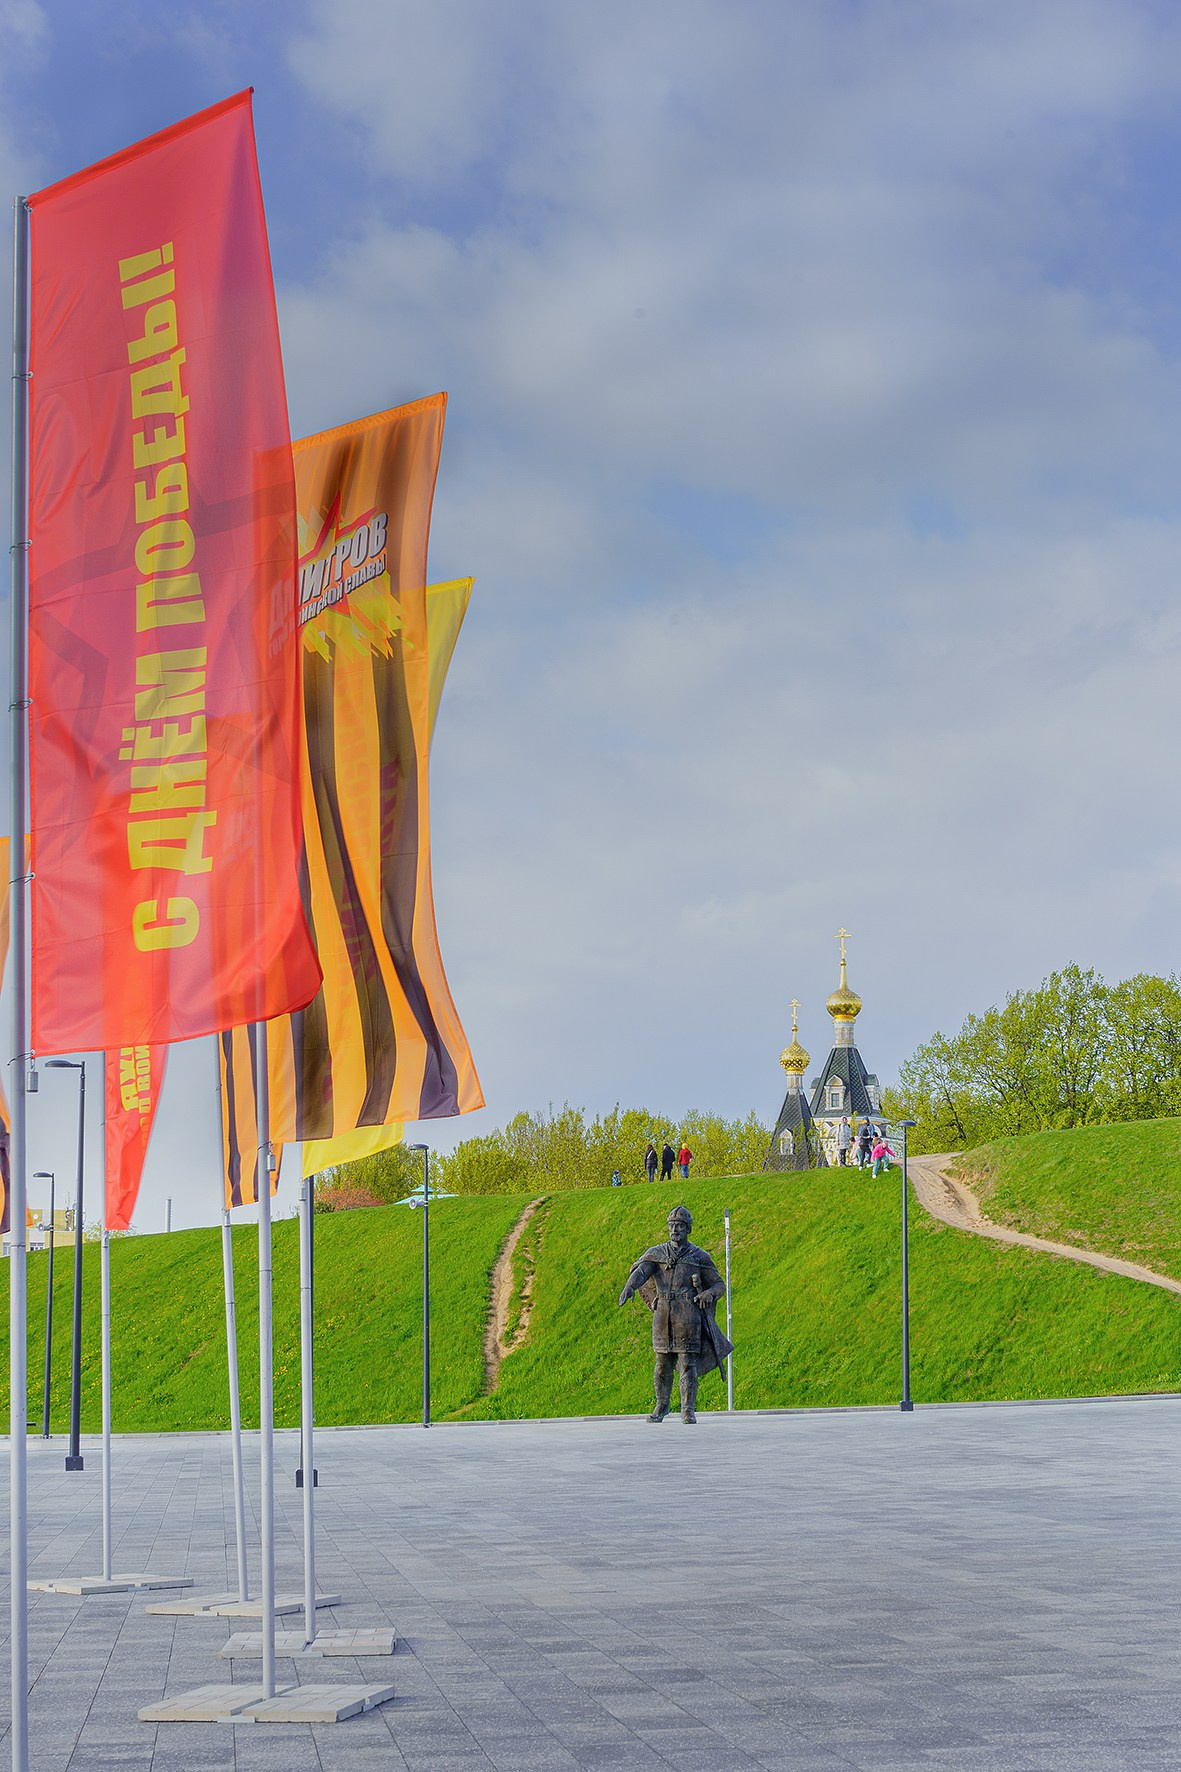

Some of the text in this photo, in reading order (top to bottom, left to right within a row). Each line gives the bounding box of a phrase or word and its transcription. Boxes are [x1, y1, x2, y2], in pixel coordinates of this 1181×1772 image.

[118, 241, 217, 952] С ДНЁМ ПОБЕДЫ!
[344, 553, 387, 595] СЛАВЫ
